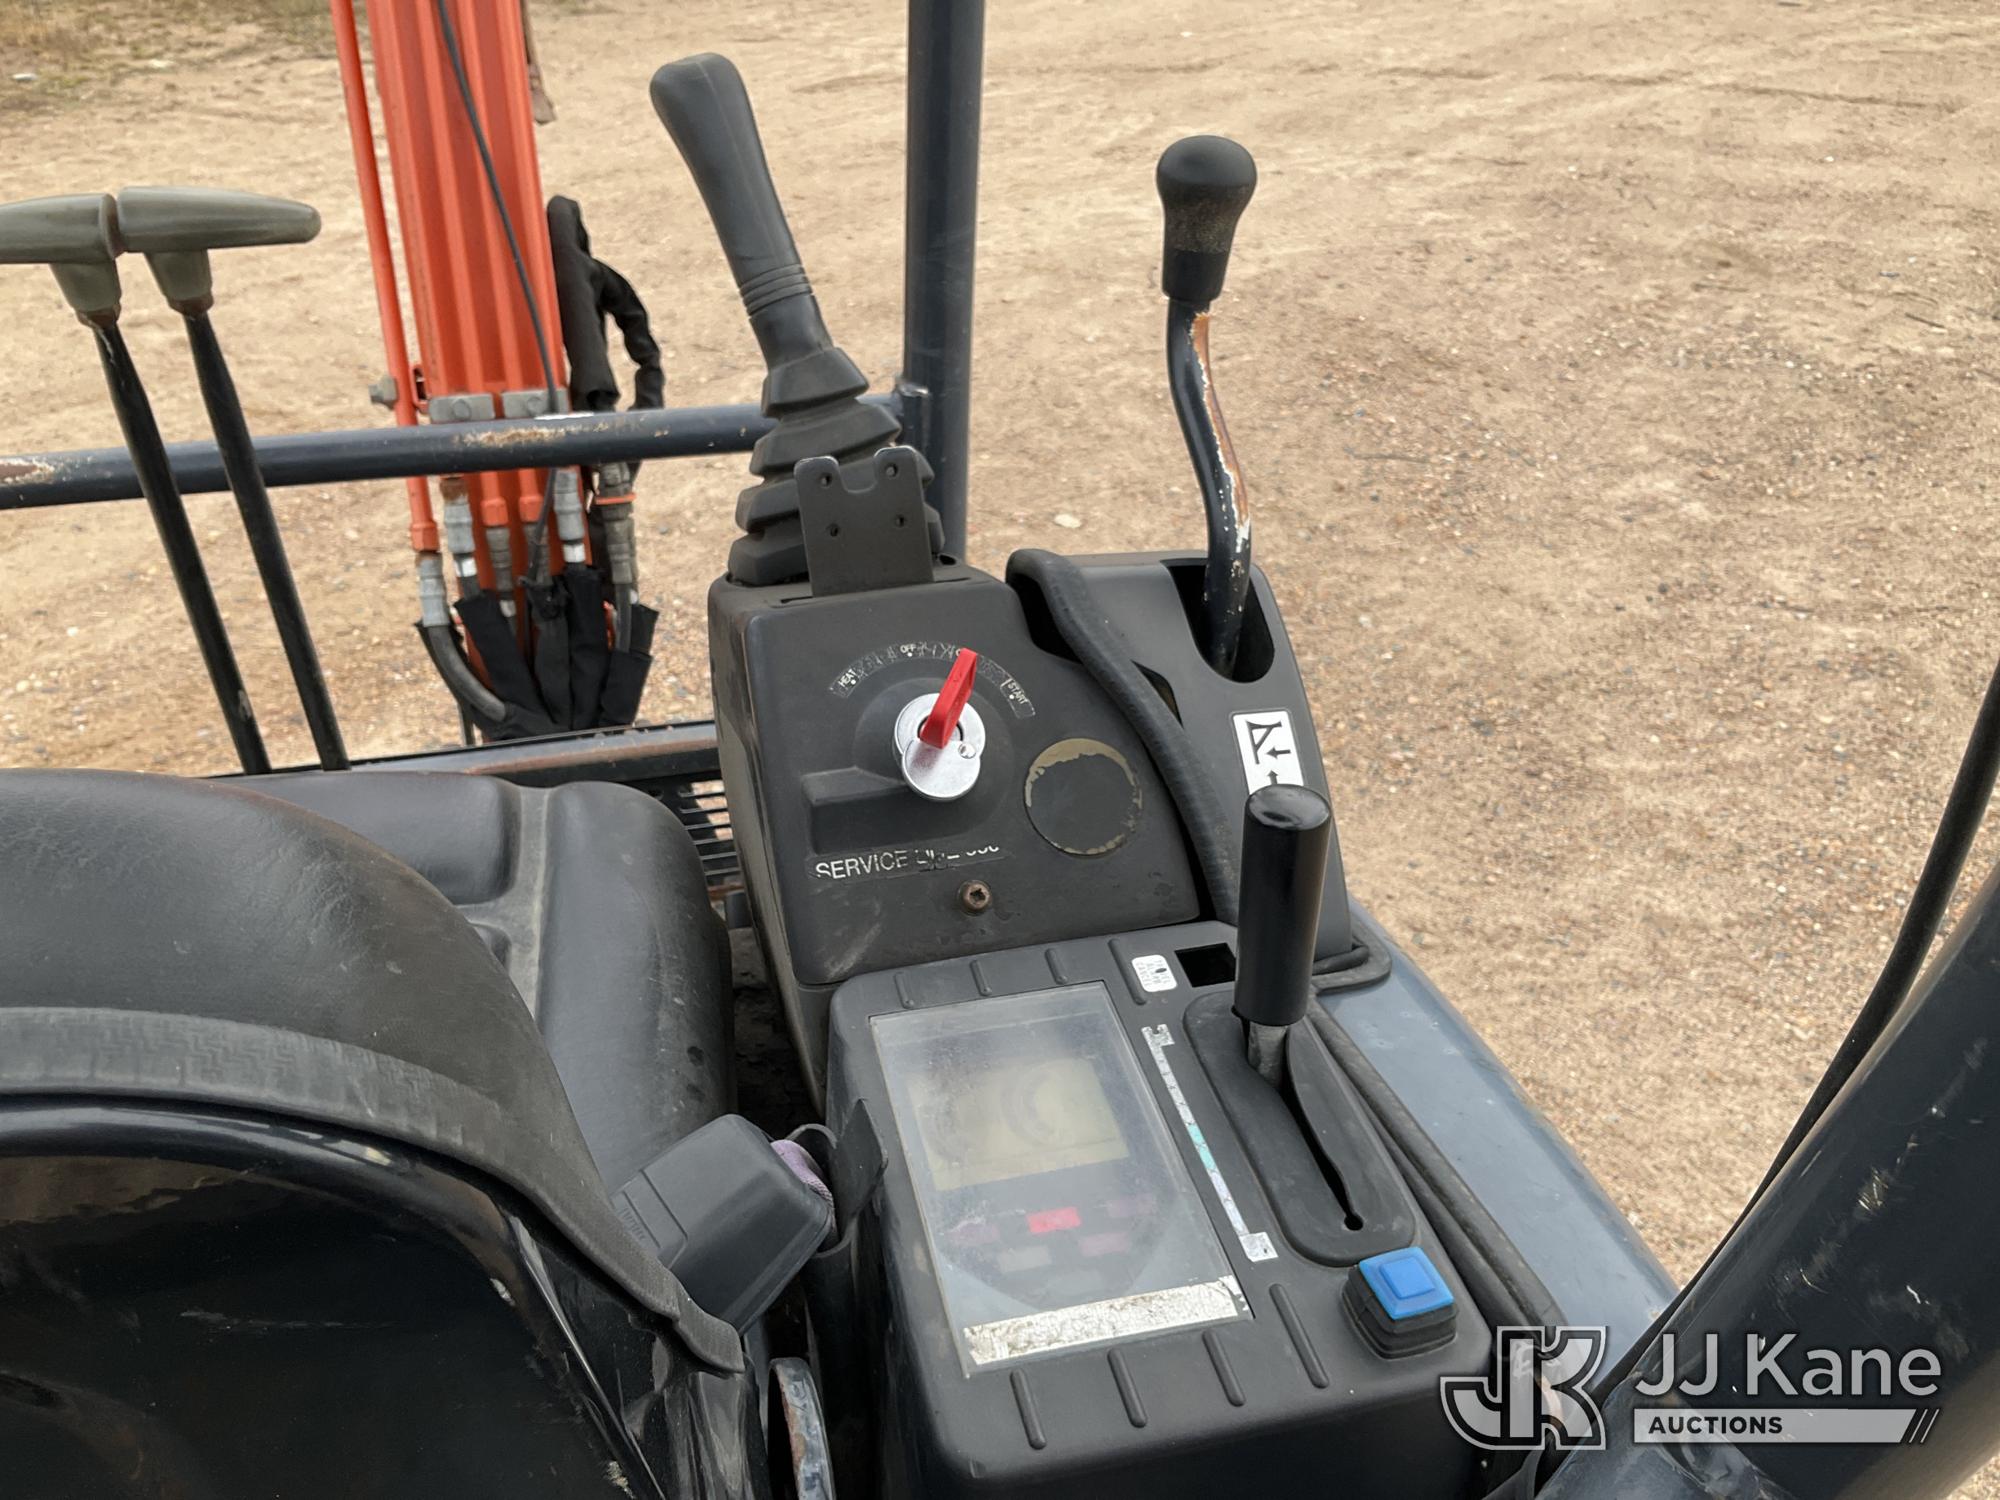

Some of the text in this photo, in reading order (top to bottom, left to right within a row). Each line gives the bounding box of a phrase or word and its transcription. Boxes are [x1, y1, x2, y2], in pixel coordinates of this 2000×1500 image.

[900, 643, 917, 653] OFF
[838, 668, 858, 687] HEAT
[1008, 681, 1030, 704] START
[815, 851, 909, 879] SERVICE
